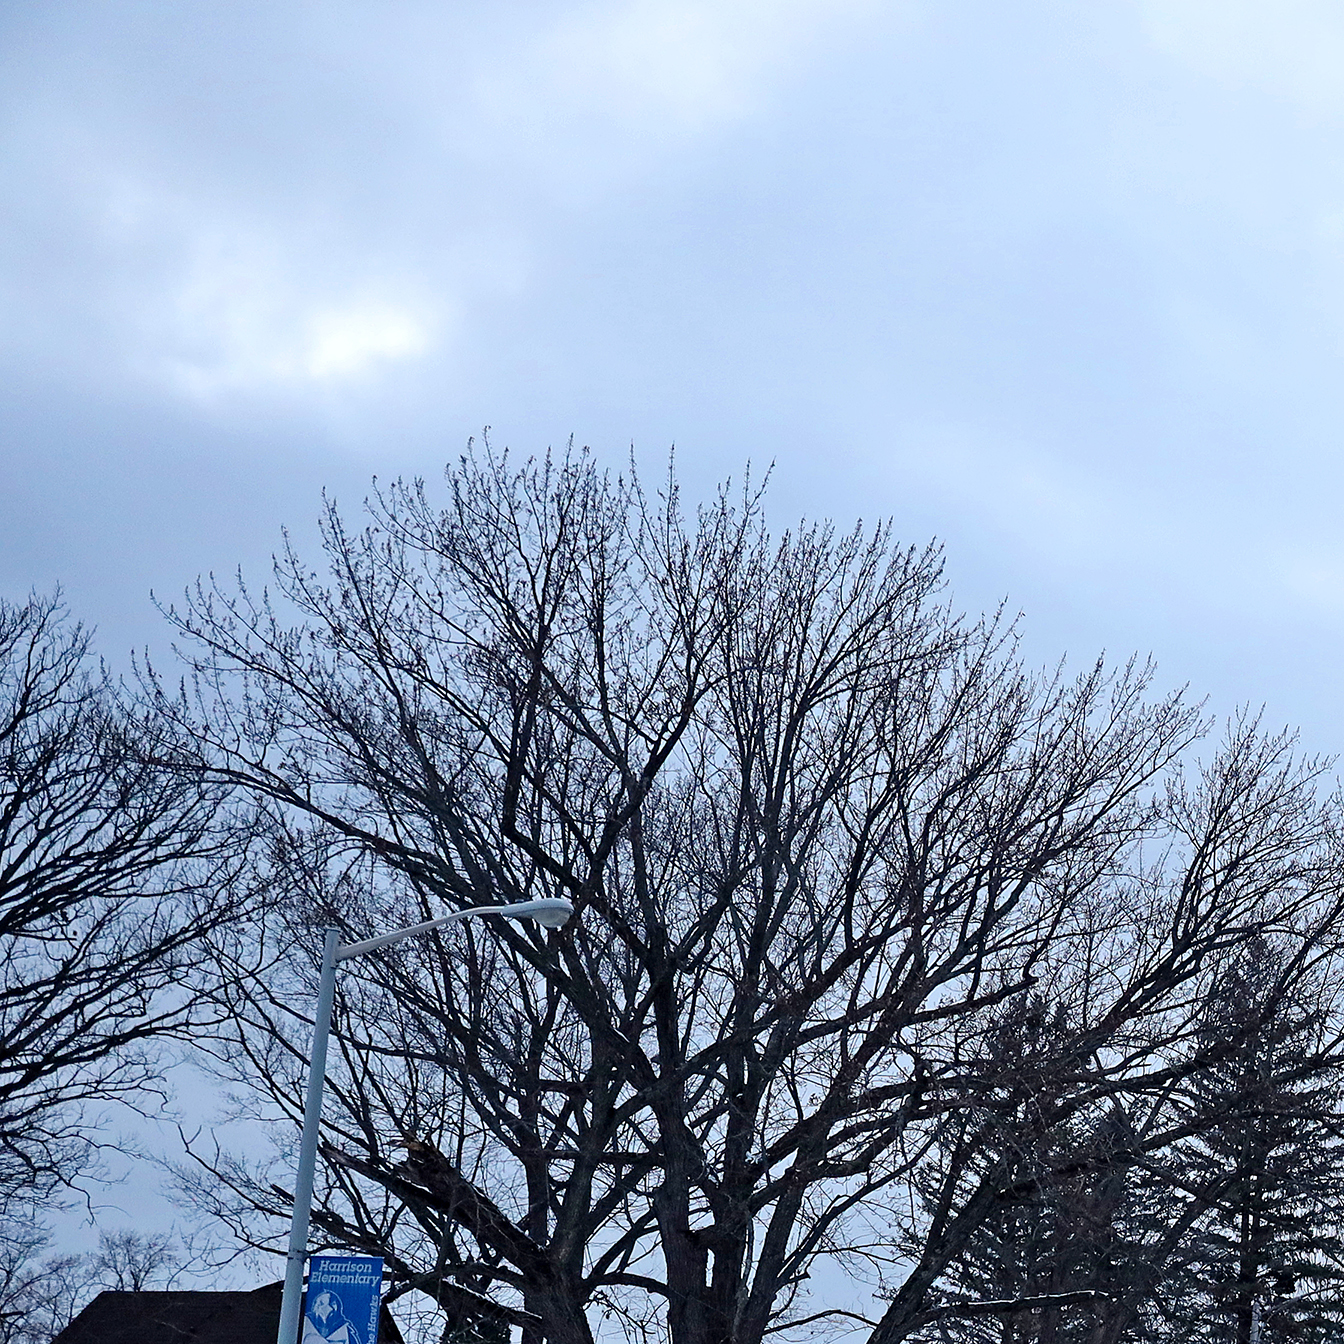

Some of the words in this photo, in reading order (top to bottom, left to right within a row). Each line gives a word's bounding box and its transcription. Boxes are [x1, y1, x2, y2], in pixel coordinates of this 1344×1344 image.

[319, 1260, 372, 1273] Harrison
[311, 1272, 380, 1286] Elementary
[367, 1294, 379, 1332] Hawks
